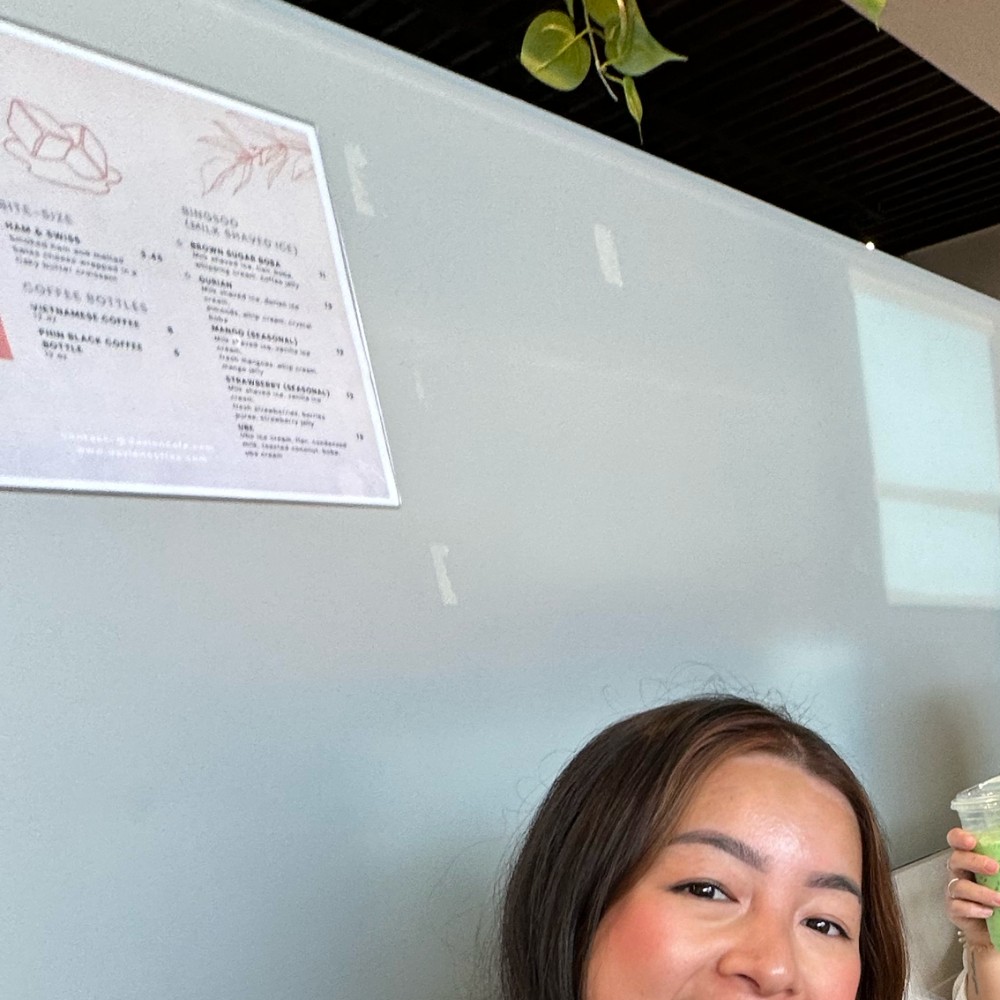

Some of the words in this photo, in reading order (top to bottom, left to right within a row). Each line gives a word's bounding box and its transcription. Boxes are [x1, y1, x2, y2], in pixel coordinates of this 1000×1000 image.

[5, 221, 31, 233] HAM
[46, 229, 81, 244] SWISS
[224, 228, 272, 248] SHAVED
[190, 241, 224, 256] BROWN
[226, 248, 256, 263] SUGAR
[258, 256, 281, 268] BOBA
[198, 275, 233, 290] DURIAN
[22, 281, 82, 301] COFFEE
[86, 292, 148, 314] BOTTLES
[30, 303, 98, 321] VIETNAMESE
[101, 313, 139, 328] COFFEE
[42, 340, 83, 354] BOTTLE
[67, 331, 101, 346] BLACK
[105, 337, 143, 352] COFFEE
[211, 324, 245, 337] MANGO
[247, 328, 298, 347] (SEASONAL)
[225, 375, 280, 389] STRAWBERRY
[283, 383, 330, 398] (SEASONAL)
